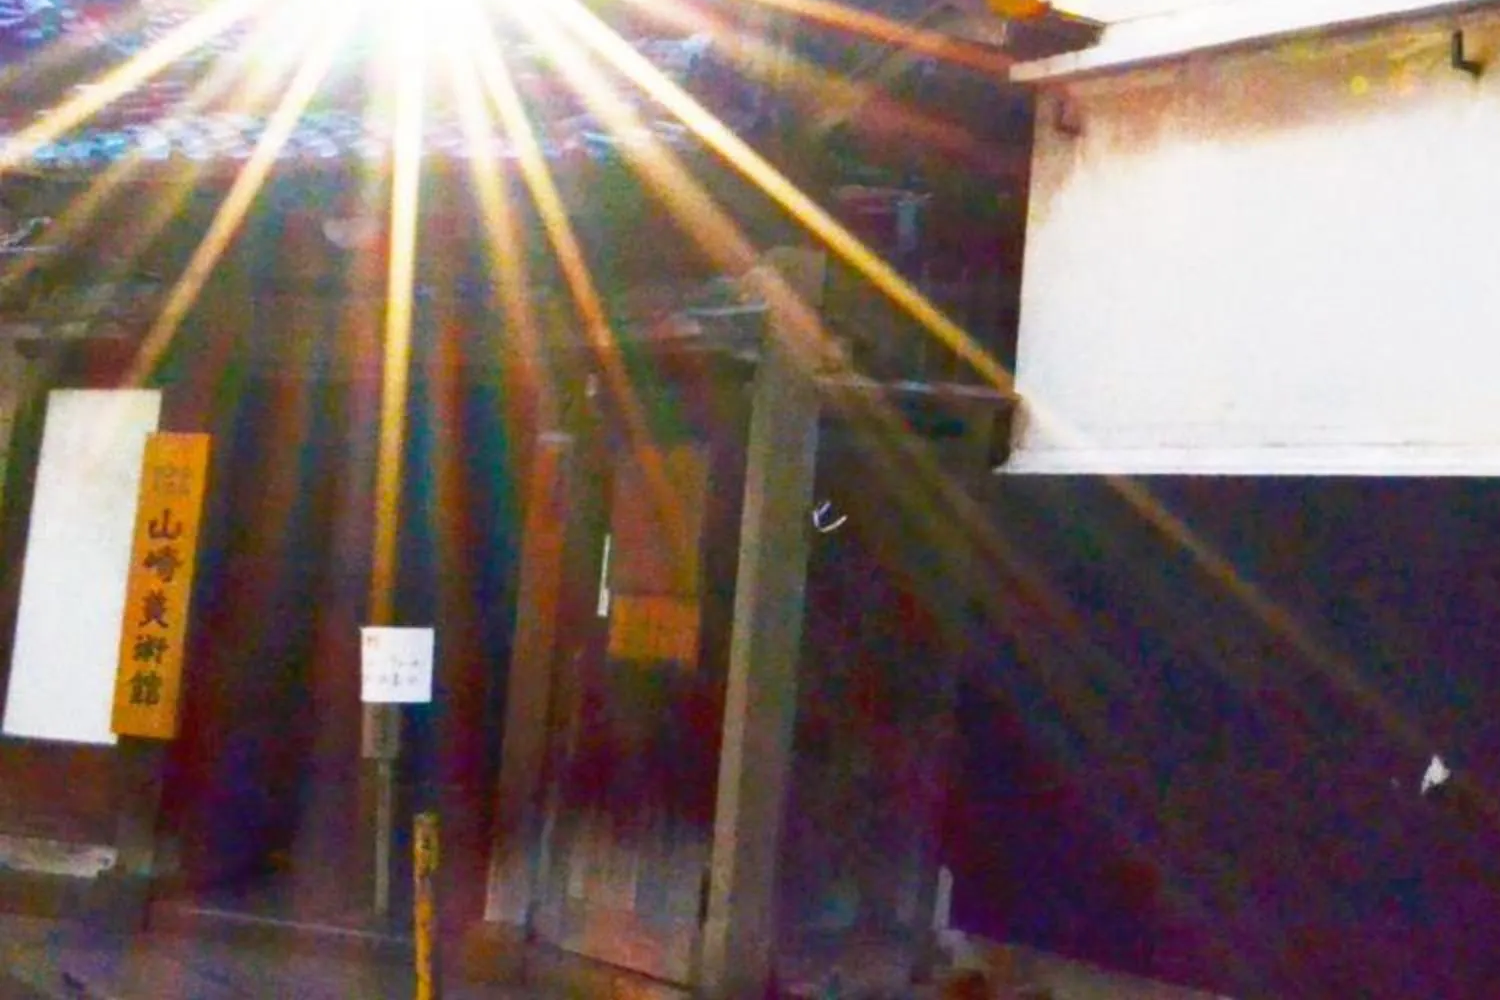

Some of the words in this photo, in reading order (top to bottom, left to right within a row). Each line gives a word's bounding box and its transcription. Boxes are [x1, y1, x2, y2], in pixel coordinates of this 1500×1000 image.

[129, 508, 183, 706] 山崎美術館
